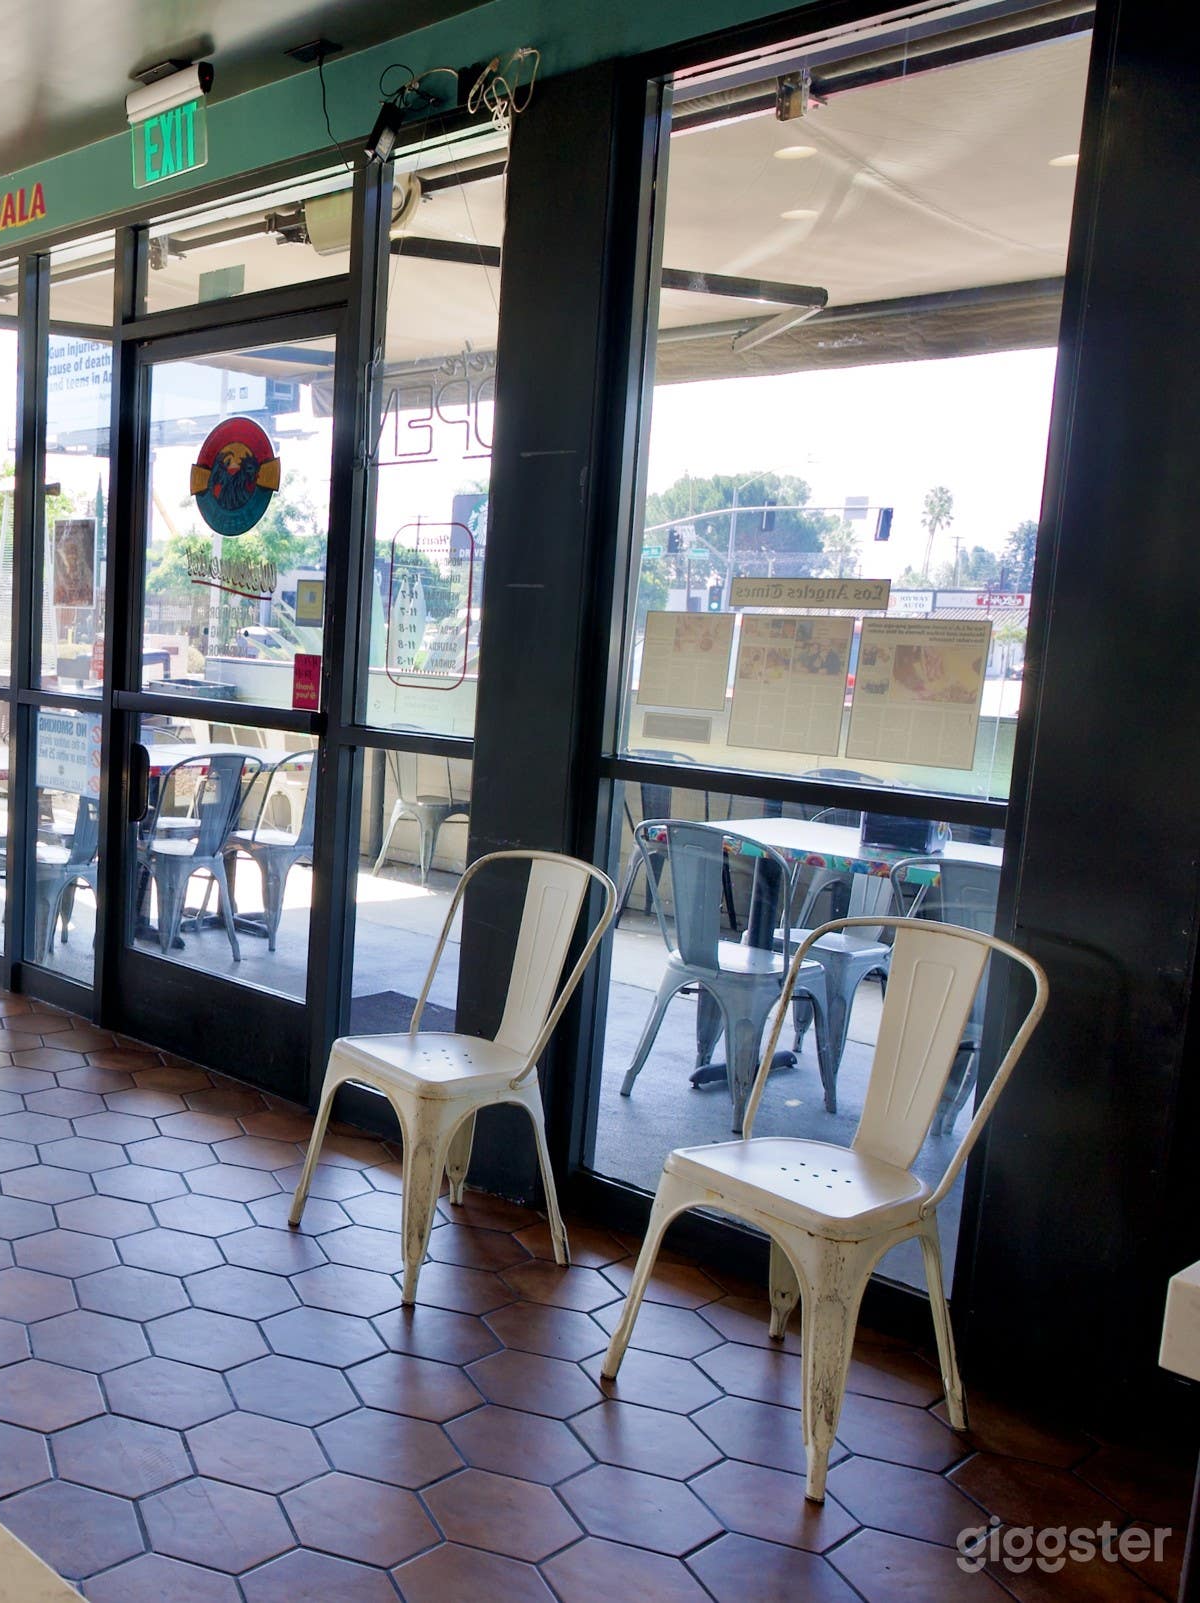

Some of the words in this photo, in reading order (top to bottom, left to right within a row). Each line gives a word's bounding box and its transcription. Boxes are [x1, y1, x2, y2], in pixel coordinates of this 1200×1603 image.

[145, 102, 197, 181] EXIT
[67, 341, 101, 358] injuries
[74, 357, 83, 372] of
[85, 352, 111, 370] death
[92, 371, 101, 385] in
